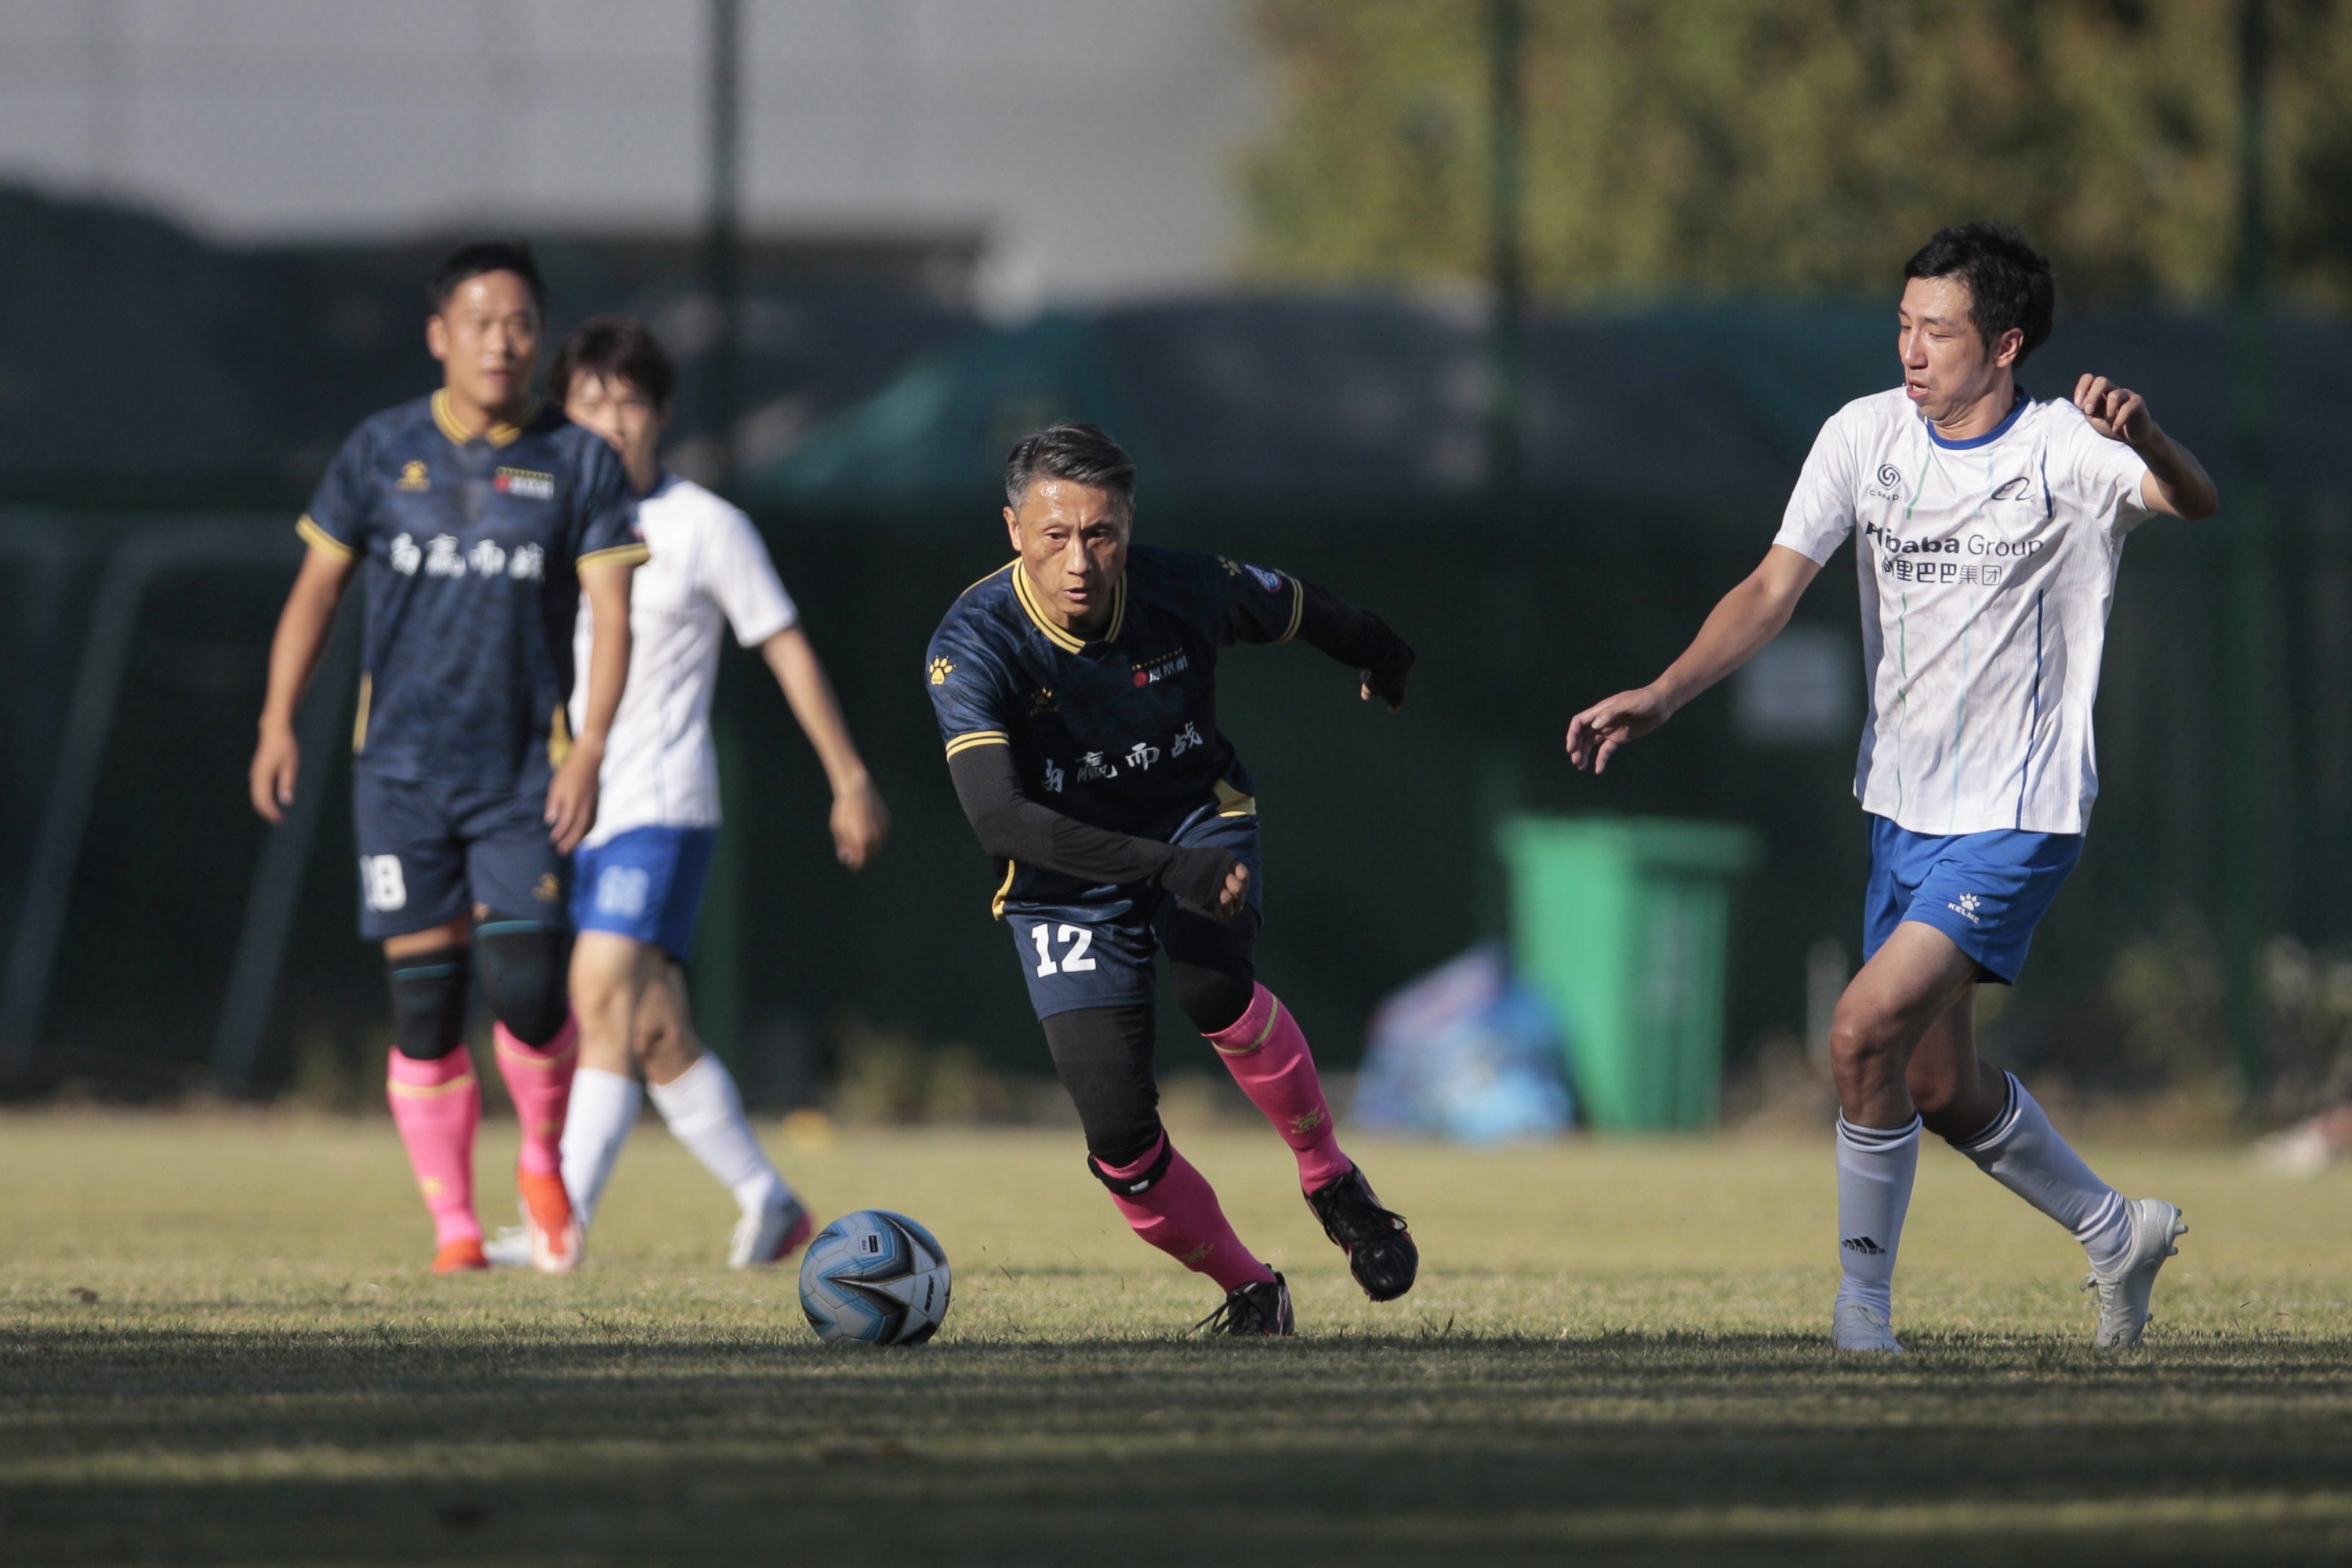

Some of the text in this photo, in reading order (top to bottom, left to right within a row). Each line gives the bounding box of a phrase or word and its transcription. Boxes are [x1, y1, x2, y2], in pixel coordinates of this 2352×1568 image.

[1967, 534, 2044, 558] Group
[360, 854, 407, 913] 18
[1947, 902, 1980, 924] KELME
[1031, 923, 1096, 978] 12
[1842, 1240, 1886, 1254] adidas
